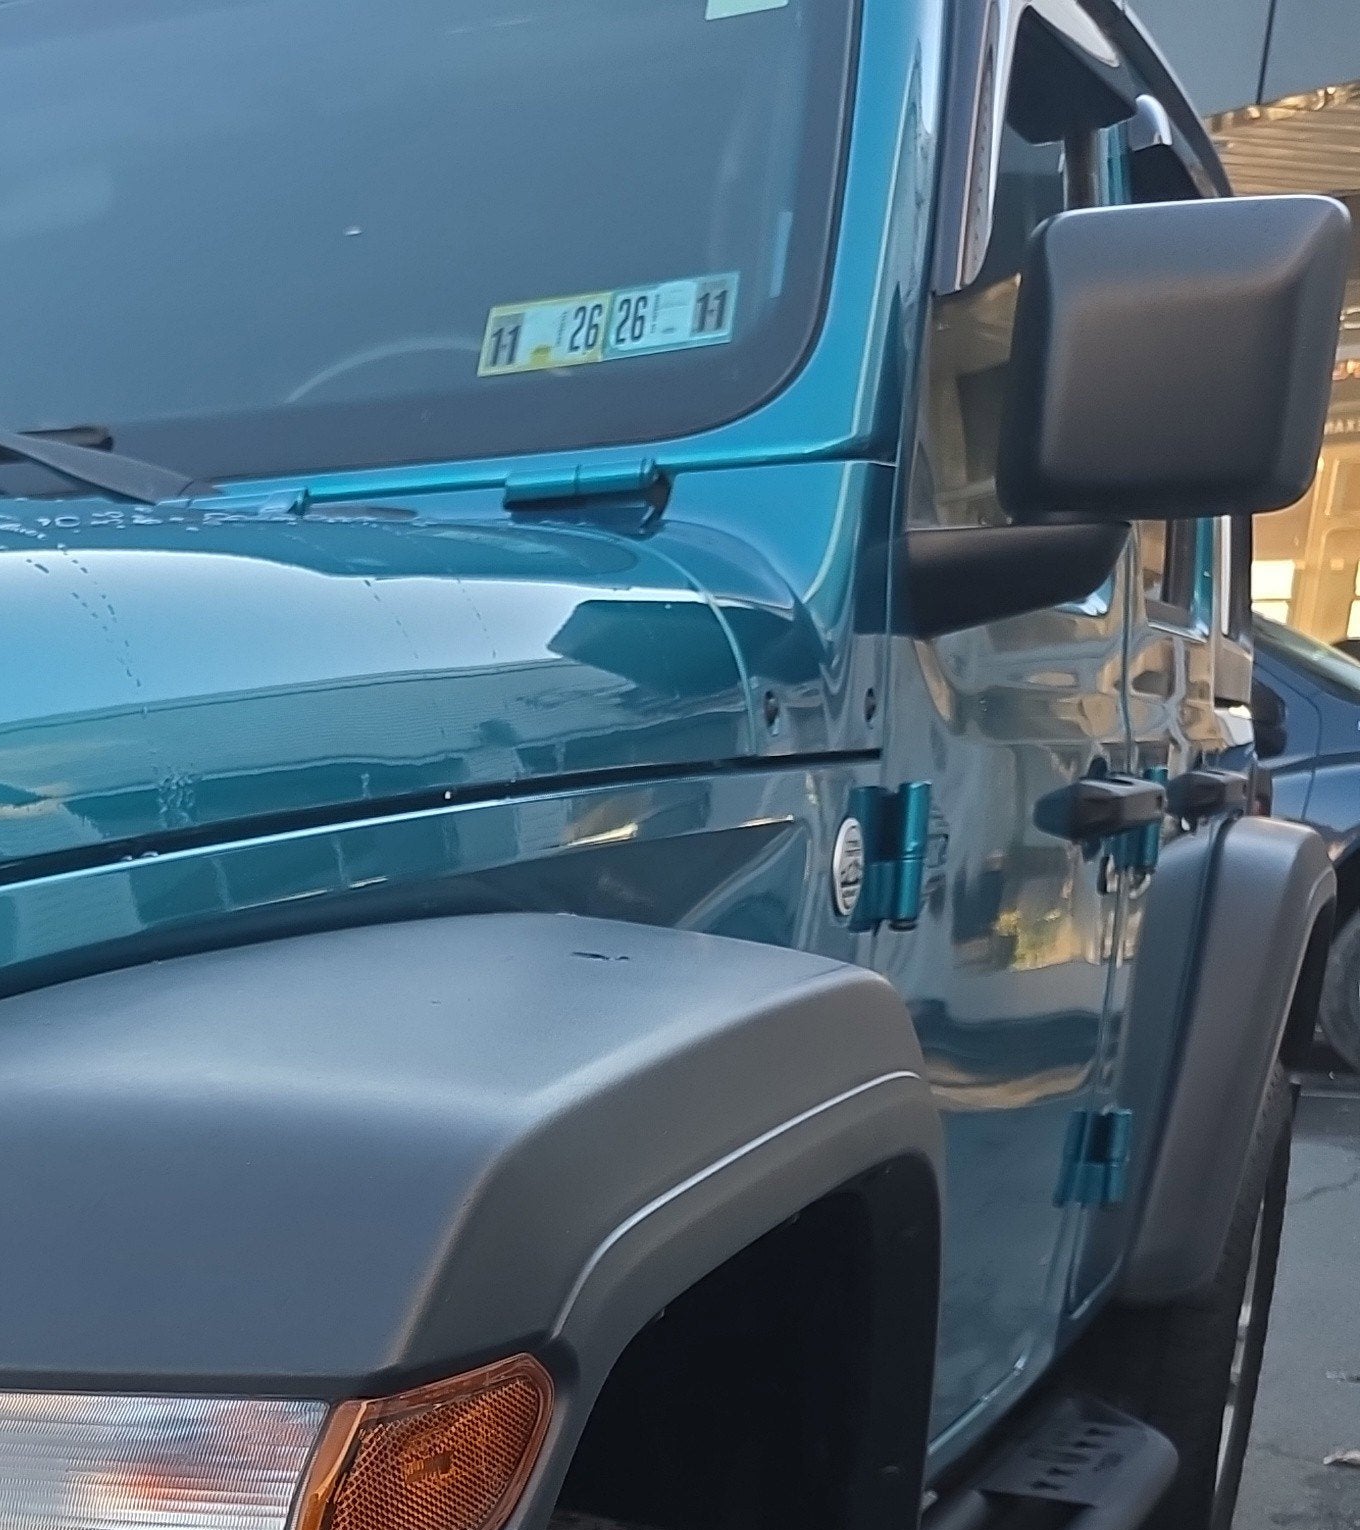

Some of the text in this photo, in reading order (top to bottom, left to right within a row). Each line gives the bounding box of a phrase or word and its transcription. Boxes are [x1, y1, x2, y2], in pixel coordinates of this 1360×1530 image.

[490, 326, 522, 367] 11
[568, 304, 603, 352] 26
[615, 296, 648, 344] 26
[694, 290, 728, 333] 11
